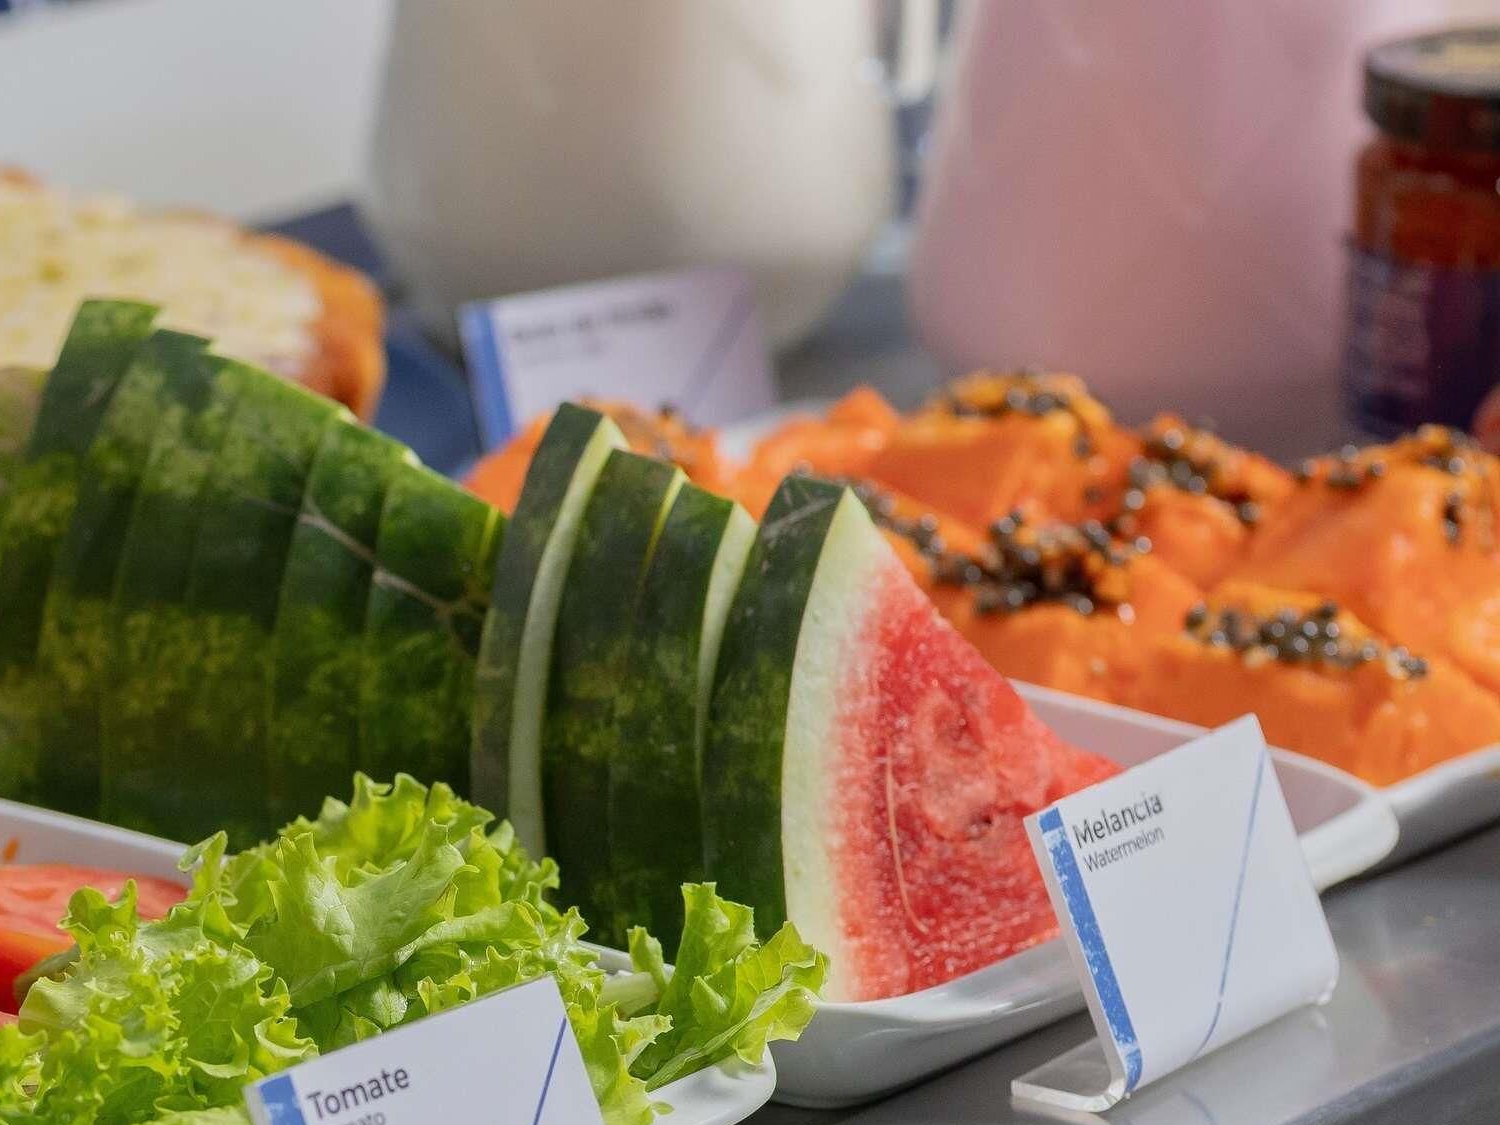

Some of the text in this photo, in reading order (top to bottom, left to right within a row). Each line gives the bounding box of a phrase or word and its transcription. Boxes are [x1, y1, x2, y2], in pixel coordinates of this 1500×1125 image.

[1072, 792, 1164, 848] Melancia
[1083, 826, 1165, 873] Watermelon
[308, 1067, 410, 1119] Tomate
